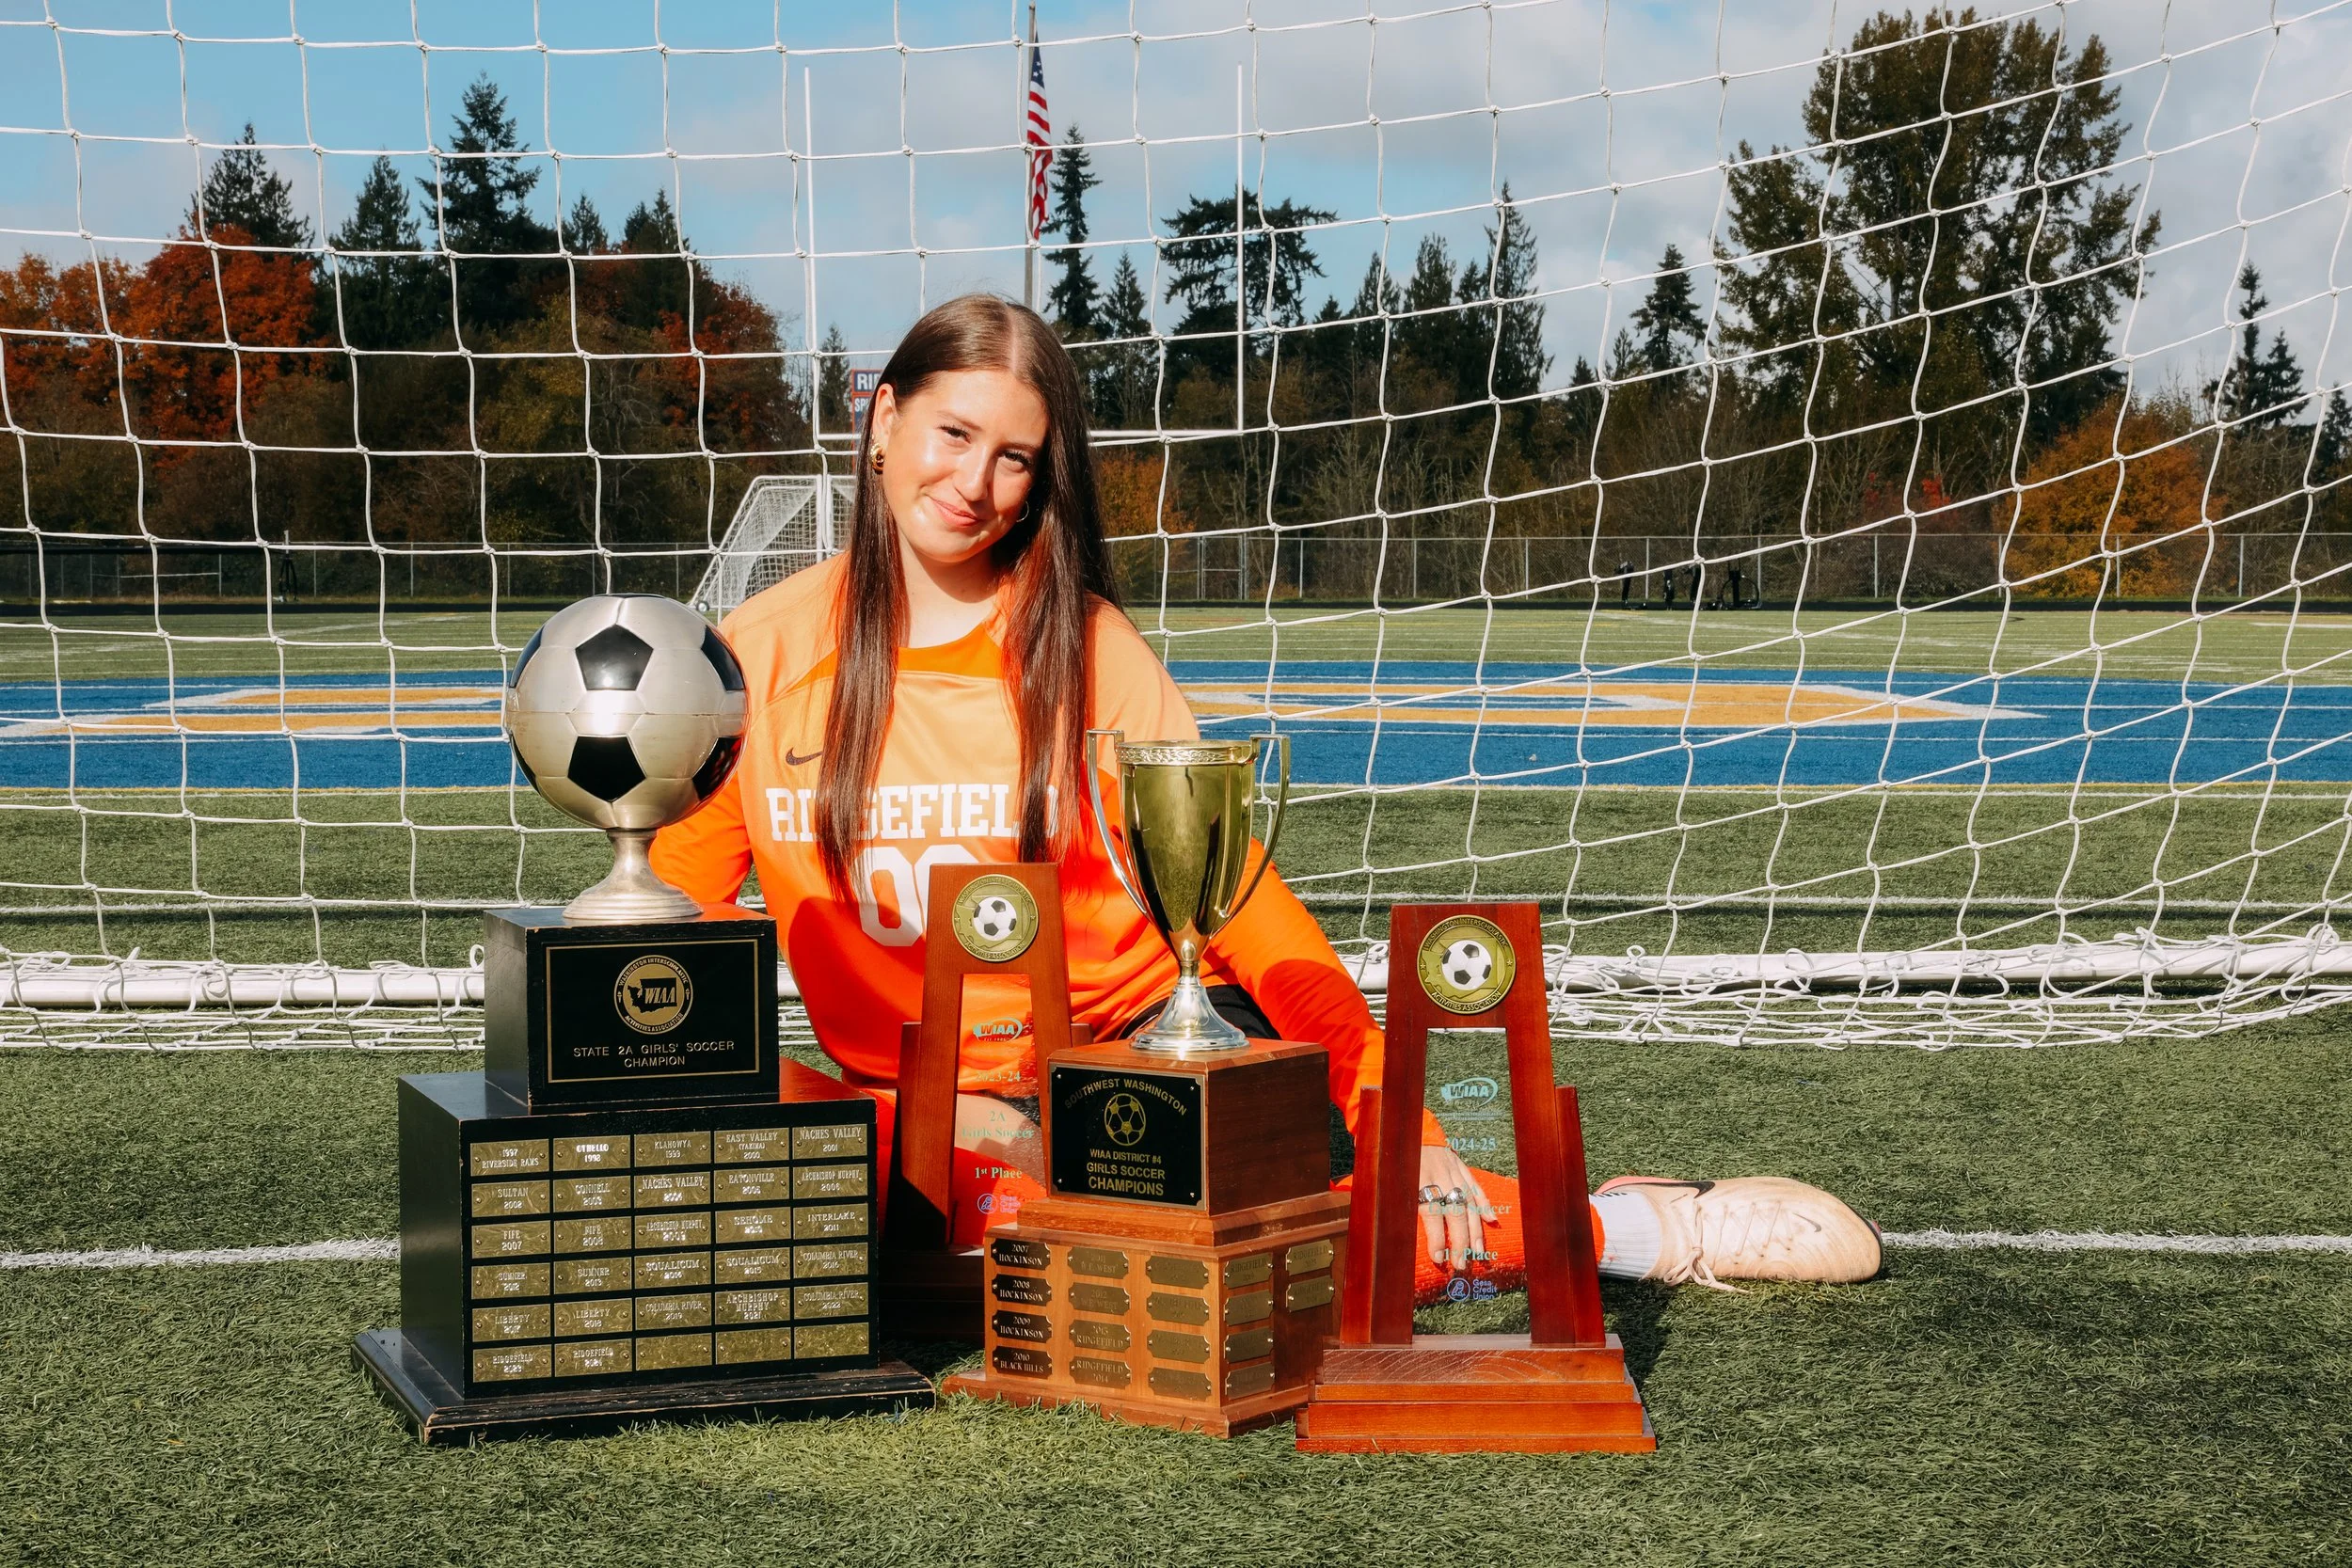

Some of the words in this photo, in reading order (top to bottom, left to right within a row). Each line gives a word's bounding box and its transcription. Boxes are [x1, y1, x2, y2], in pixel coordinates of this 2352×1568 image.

[1423, 919, 1459, 951] WASHINGTON
[1459, 918, 1509, 947] INTERSCHOLASTIC
[619, 959, 647, 986] WASHINGTON
[647, 958, 688, 984] INTERSCHOLASTIC
[644, 987, 676, 1004] WIAA
[1431, 991, 1462, 1010] ACTIVITIES
[1463, 991, 1502, 1011] ASSOCIATION
[625, 1015, 651, 1033] ACTIVITIES
[651, 1013, 684, 1032] ASSOCIATION
[981, 1023, 1016, 1036] WIAA
[573, 1046, 610, 1057] STATE
[618, 1045, 633, 1055] 2A
[641, 1043, 679, 1053] GIRLS'
[686, 1040, 735, 1053] SOCCER
[624, 1055, 686, 1069] CHAMPION
[1064, 1078, 1120, 1109] SOUTHWEST
[1123, 1078, 1187, 1117] WASHINGTON
[1450, 1085, 1489, 1098] WIAA
[989, 1110, 1006, 1122] 2A
[726, 1133, 745, 1143] EAST
[750, 1132, 778, 1142] VALLEY
[800, 1129, 830, 1141] NACHES
[833, 1127, 862, 1138] VALLEY
[576, 1143, 610, 1153] OTHELLO
[654, 1139, 691, 1149] KLAHOWYA
[822, 1144, 838, 1152] 2001
[502, 1148, 518, 1158] 1997
[584, 1154, 601, 1163] 1998
[743, 1151, 761, 1160] 2000
[1089, 1148, 1111, 1159] WIAA
[1113, 1150, 1151, 1163] DISTRICT
[1152, 1155, 1162, 1164] #4
[482, 1159, 517, 1169] RIVERSIDE
[520, 1158, 539, 1167] RAMS
[975, 1166, 987, 1179] 1st
[991, 1166, 1023, 1179] Place
[1086, 1162, 1118, 1175] GIRLS
[1120, 1165, 1166, 1180] SOCCER
[642, 1178, 673, 1189] NACHES
[675, 1176, 704, 1187] VALLEY
[728, 1172, 775, 1184] EATONVILLE
[575, 1183, 611, 1195] CONNELL
[1088, 1176, 1165, 1196] CHAMPIONS
[498, 1187, 529, 1198] SULTAN
[503, 1200, 523, 1210] 2002
[734, 1214, 773, 1226] SEHOME
[807, 1212, 856, 1222] INTERLAKE
[823, 1224, 839, 1232] 2011
[503, 1230, 520, 1240] FIFE
[501, 1241, 523, 1251] 2007
[1011, 1243, 1029, 1253] 2007
[803, 1251, 836, 1261] COLUMBIA
[838, 1250, 859, 1259] RIVER
[998, 1254, 1042, 1266] HOCKINSON
[1463, 1248, 1499, 1261] Place
[645, 1259, 700, 1272] SQUALICUM
[726, 1255, 779, 1267] SQUALICUM
[577, 1267, 611, 1277] SUMNER
[1097, 1263, 1117, 1274] WEST
[584, 1278, 602, 1287] 2013
[1012, 1280, 1031, 1289] 2008
[726, 1291, 779, 1304] ARCHBISHOP
[803, 1291, 836, 1302] COLUMBIA
[838, 1290, 859, 1300] RIVER
[999, 1289, 1043, 1302] HOCKINSON
[645, 1302, 679, 1312] COLUMBIA
[681, 1300, 703, 1310] RIVER
[736, 1301, 770, 1312] MURPHY
[1097, 1299, 1119, 1310] WEST
[495, 1313, 531, 1324] LIBERTY
[576, 1307, 611, 1319] LIBERTY
[1012, 1316, 1031, 1325] 2009
[999, 1325, 1044, 1339] HOCKINSON
[1076, 1334, 1123, 1348] RIDGEFIELD
[573, 1347, 613, 1358] RIDGEFIELD
[1013, 1353, 1030, 1362] 2010
[493, 1353, 534, 1365] RIDGEFIELD
[1000, 1360, 1023, 1371] BLACK
[1024, 1363, 1044, 1373] HILLS
[1076, 1359, 1123, 1374] RIDGEFIELD
[1092, 1373, 1109, 1384] 2014
